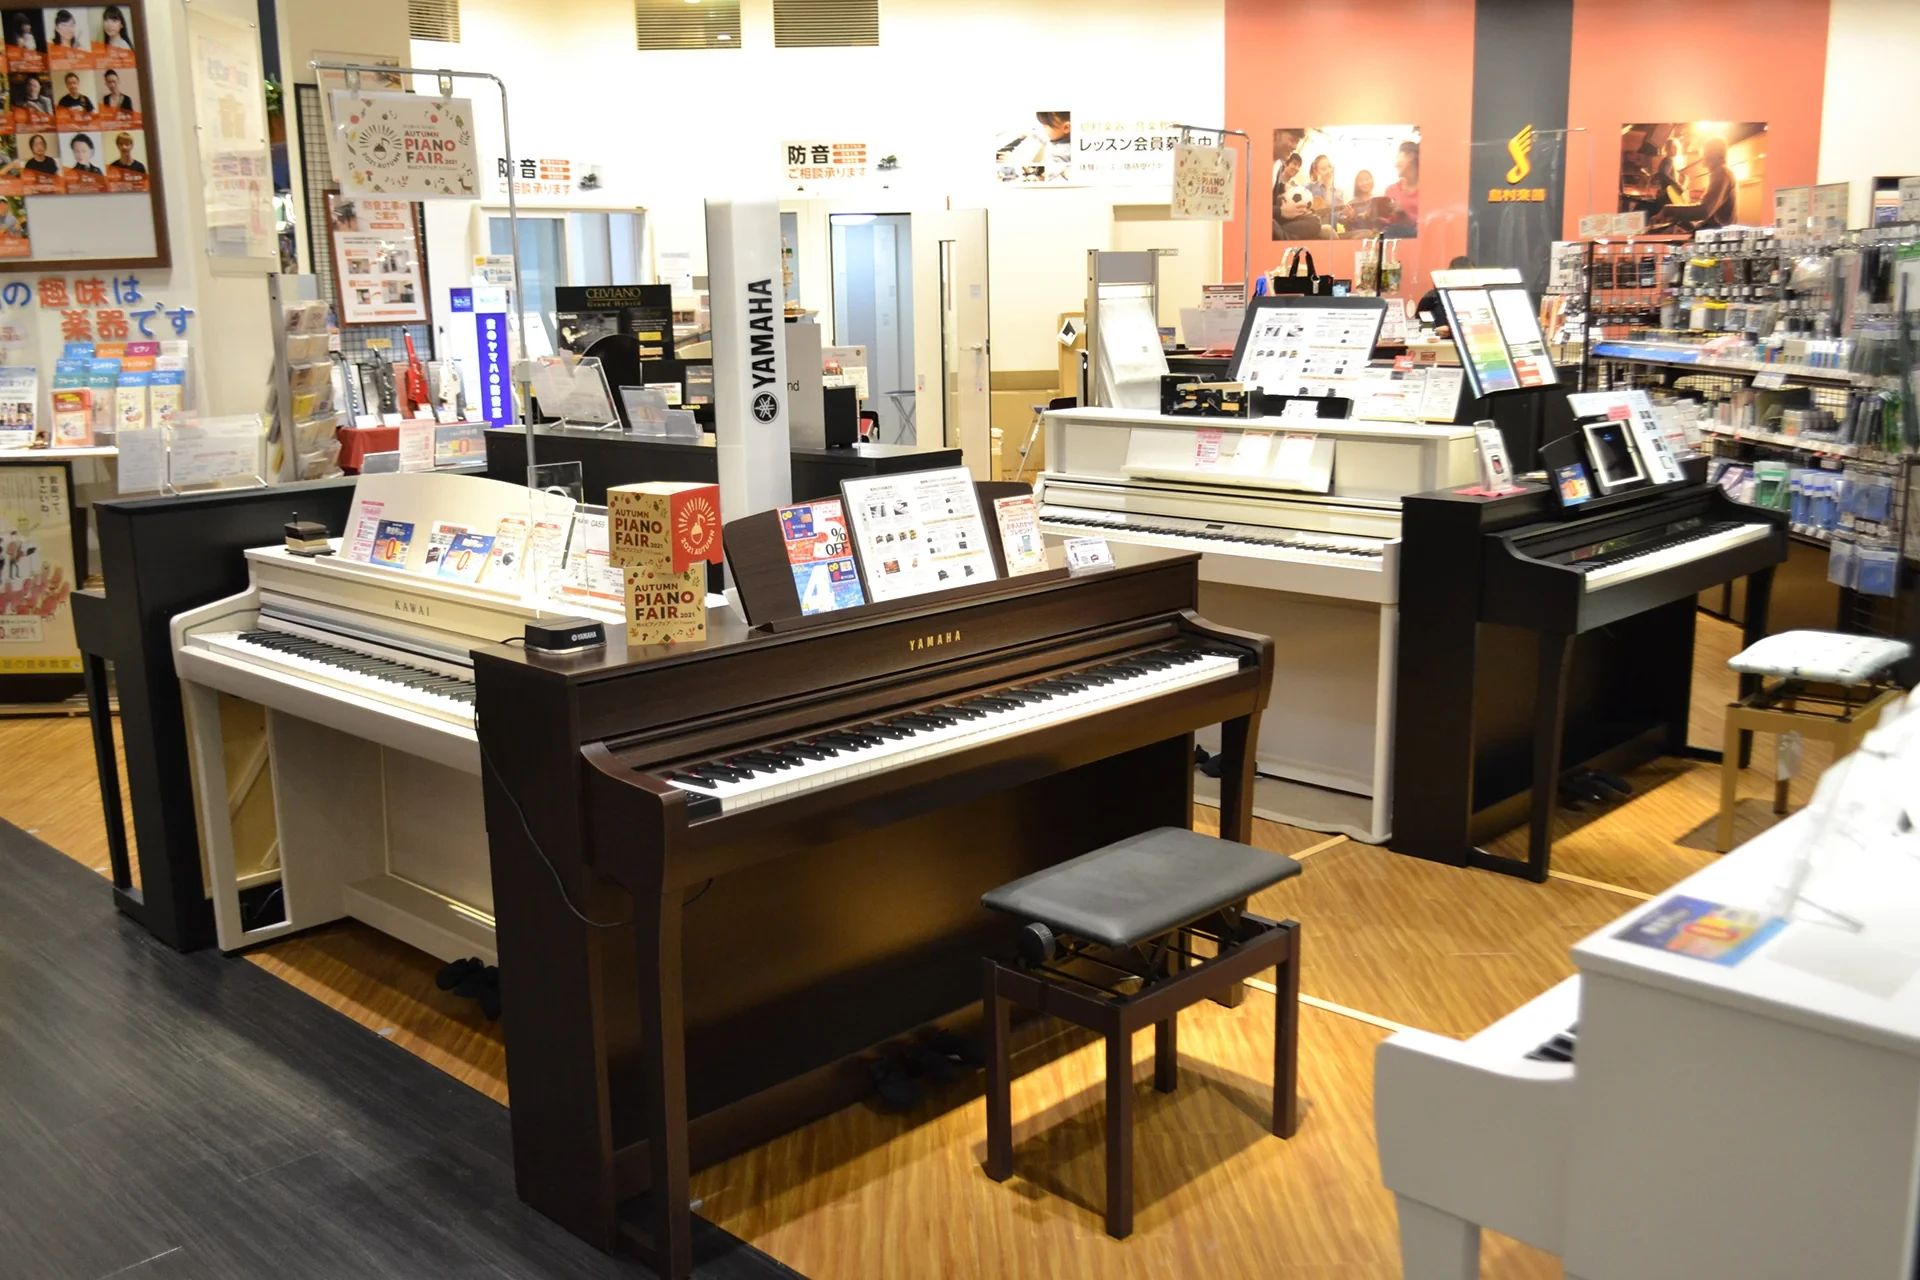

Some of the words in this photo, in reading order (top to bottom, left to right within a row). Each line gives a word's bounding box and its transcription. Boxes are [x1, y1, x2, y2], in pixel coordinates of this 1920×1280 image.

[404, 138, 456, 151] PIANO
[406, 151, 444, 164] FAIR
[787, 144, 829, 165] 防音
[787, 167, 866, 179] ご相談承ります
[1202, 176, 1225, 186] PIANO
[1201, 186, 1218, 194] FAIR
[585, 287, 642, 299] CELVIANO
[60, 302, 195, 341] 楽器です
[748, 278, 776, 389] YAMAHA
[787, 380, 800, 391] nd
[615, 509, 649, 518] AUTUMN
[615, 517, 663, 534] PIANO
[615, 532, 649, 548] FAIR
[831, 527, 847, 542] %
[825, 542, 849, 556] OFF
[635, 583, 679, 592] AUTUMN
[635, 591, 694, 607] PIANO
[394, 599, 430, 617] KAWAI
[635, 606, 679, 621] FAIR
[577, 631, 597, 640] YAMAHA
[909, 630, 961, 651] YAMAHA
